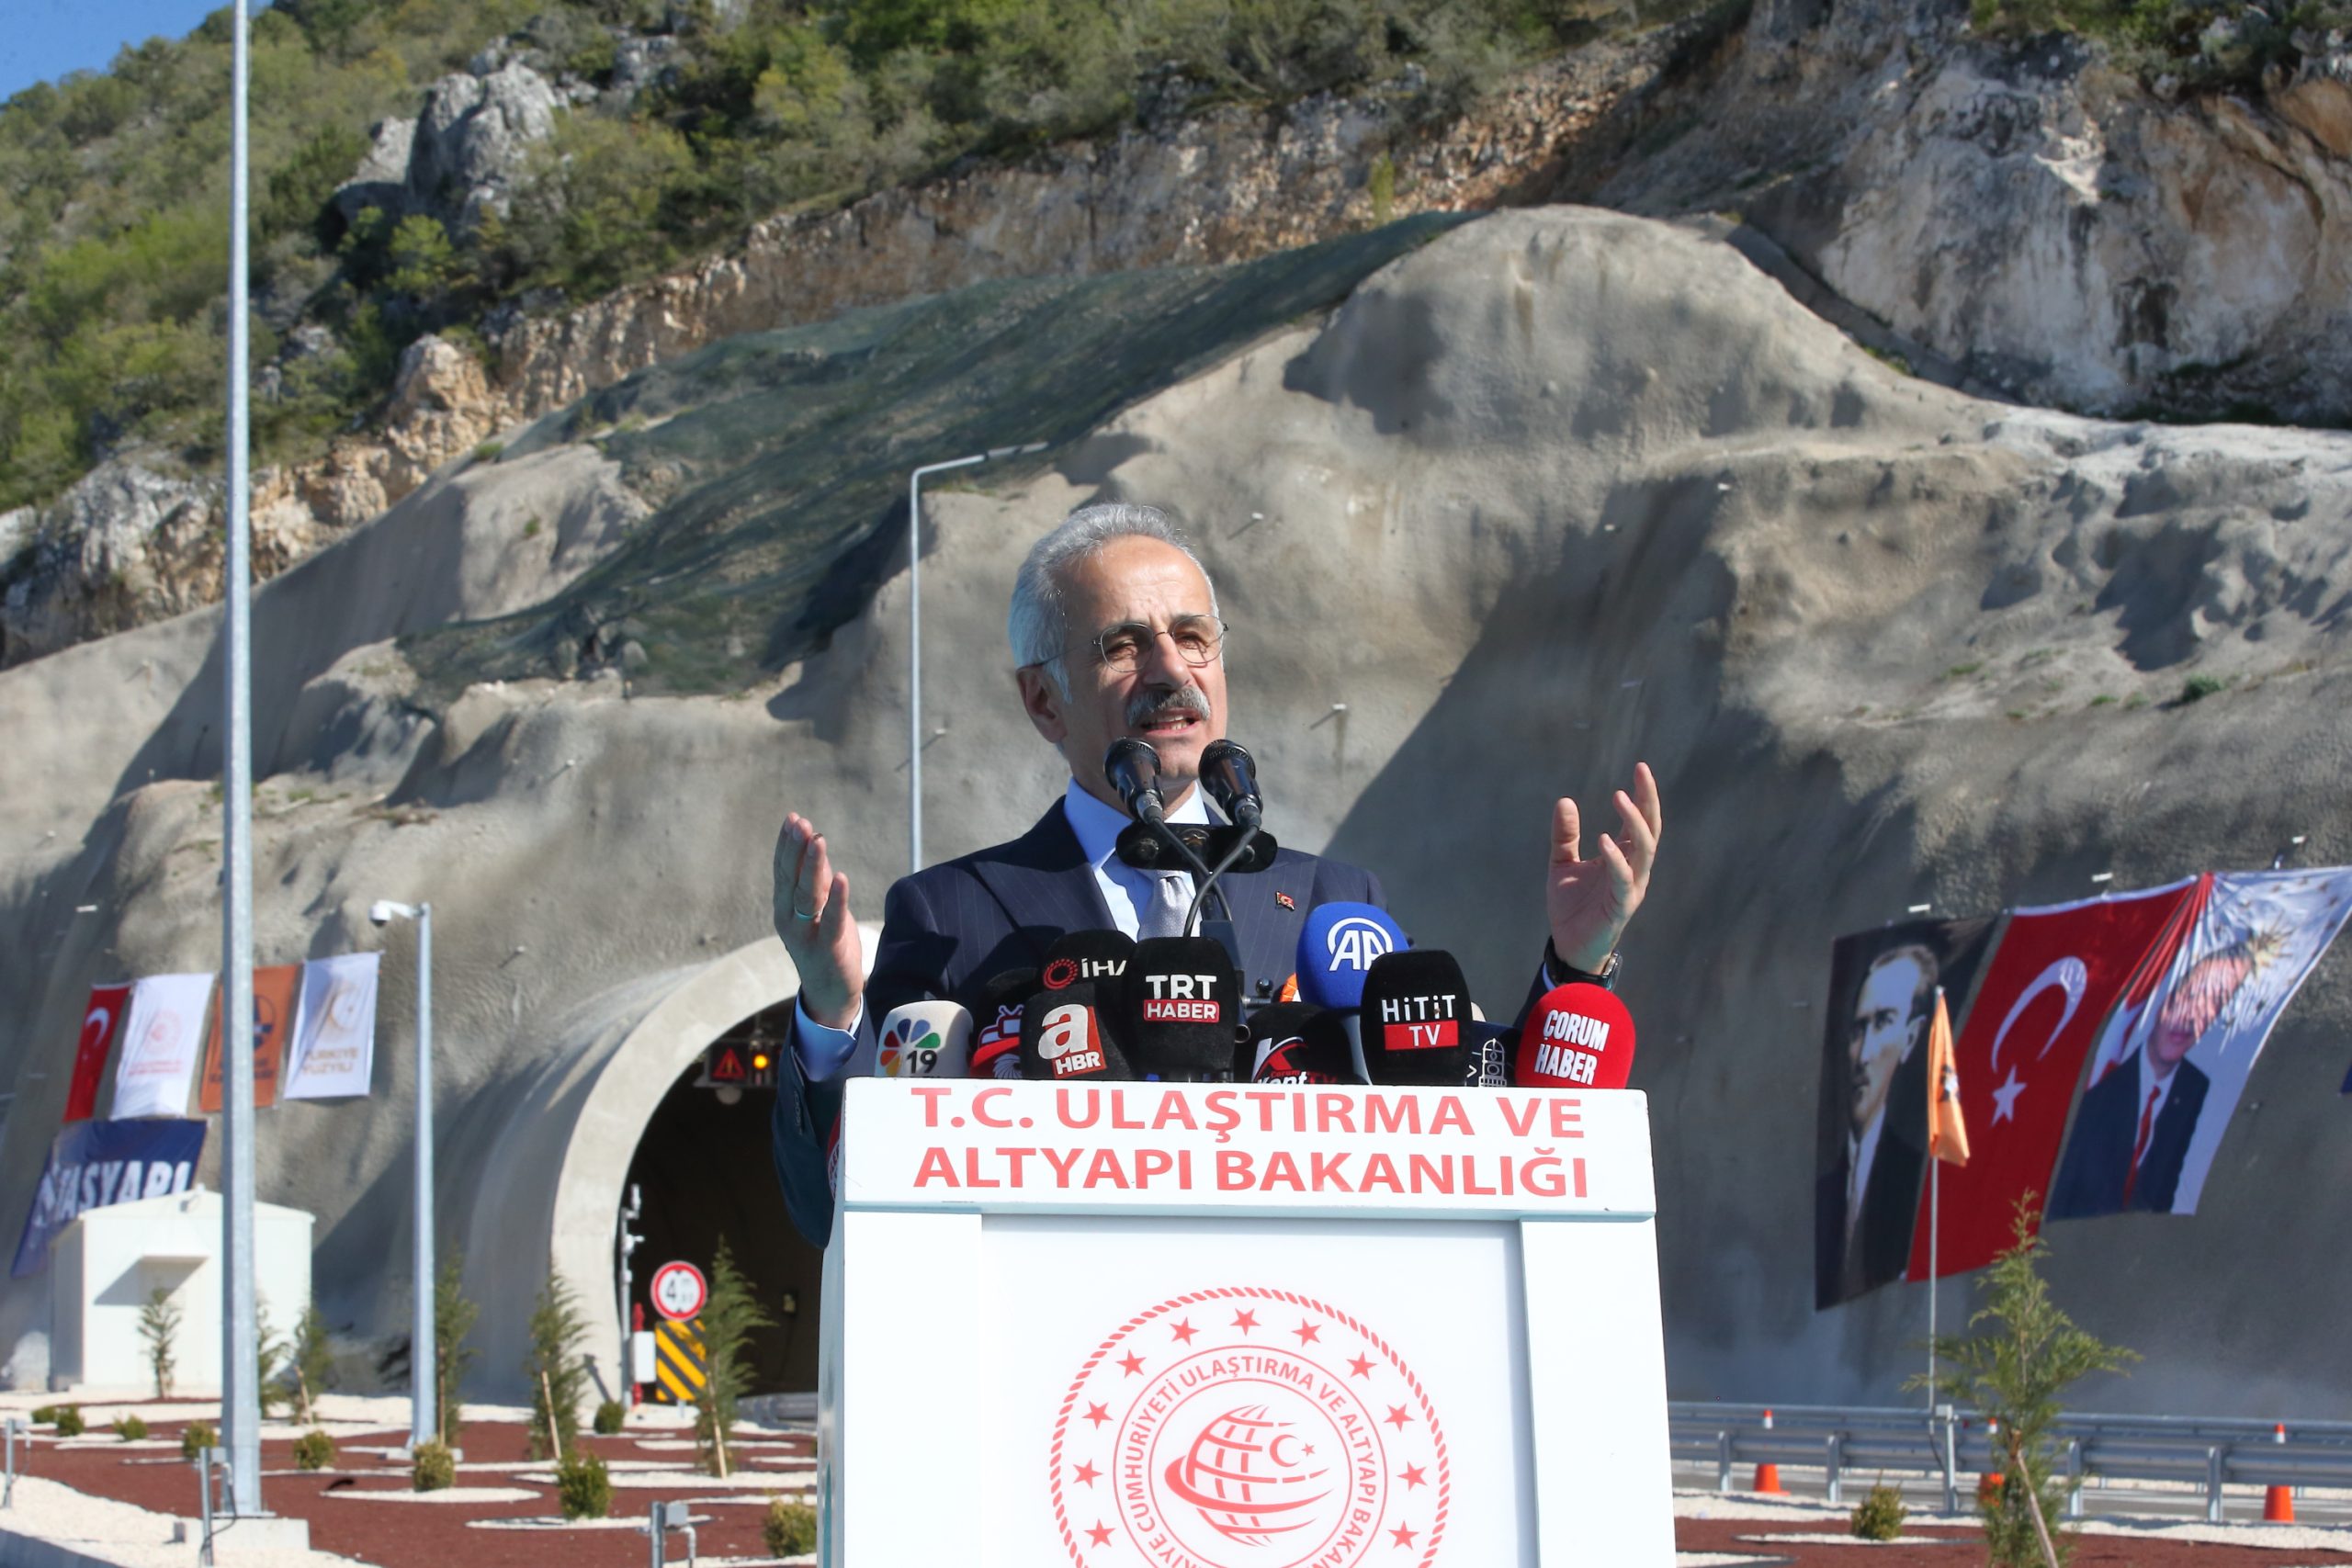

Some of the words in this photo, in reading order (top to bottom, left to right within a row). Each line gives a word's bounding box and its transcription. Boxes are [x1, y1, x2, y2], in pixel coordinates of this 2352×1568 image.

[1145, 974, 1217, 1000] TRT
[1148, 1002, 1216, 1020] HABER
[1408, 1024, 1441, 1047] TV
[1544, 1009, 1611, 1053] ÇORUM
[907, 1049, 937, 1074] 19
[1056, 1051, 1102, 1076] HBR
[1534, 1043, 1598, 1086] HABER
[911, 1086, 1034, 1128] T.C.
[1057, 1089, 1475, 1144] ULAŞTIRMA
[1497, 1098, 1584, 1138] VE
[913, 1146, 1192, 1190] ALTYAPI
[1216, 1148, 1587, 1198] BAKANLIĞI
[1125, 1378, 1182, 1532] CUMHURİYETİ
[1179, 1355, 1315, 1392] ULAŞTIRMA
[1317, 1383, 1346, 1413] VE
[1340, 1409, 1377, 1505] ALTYAPI
